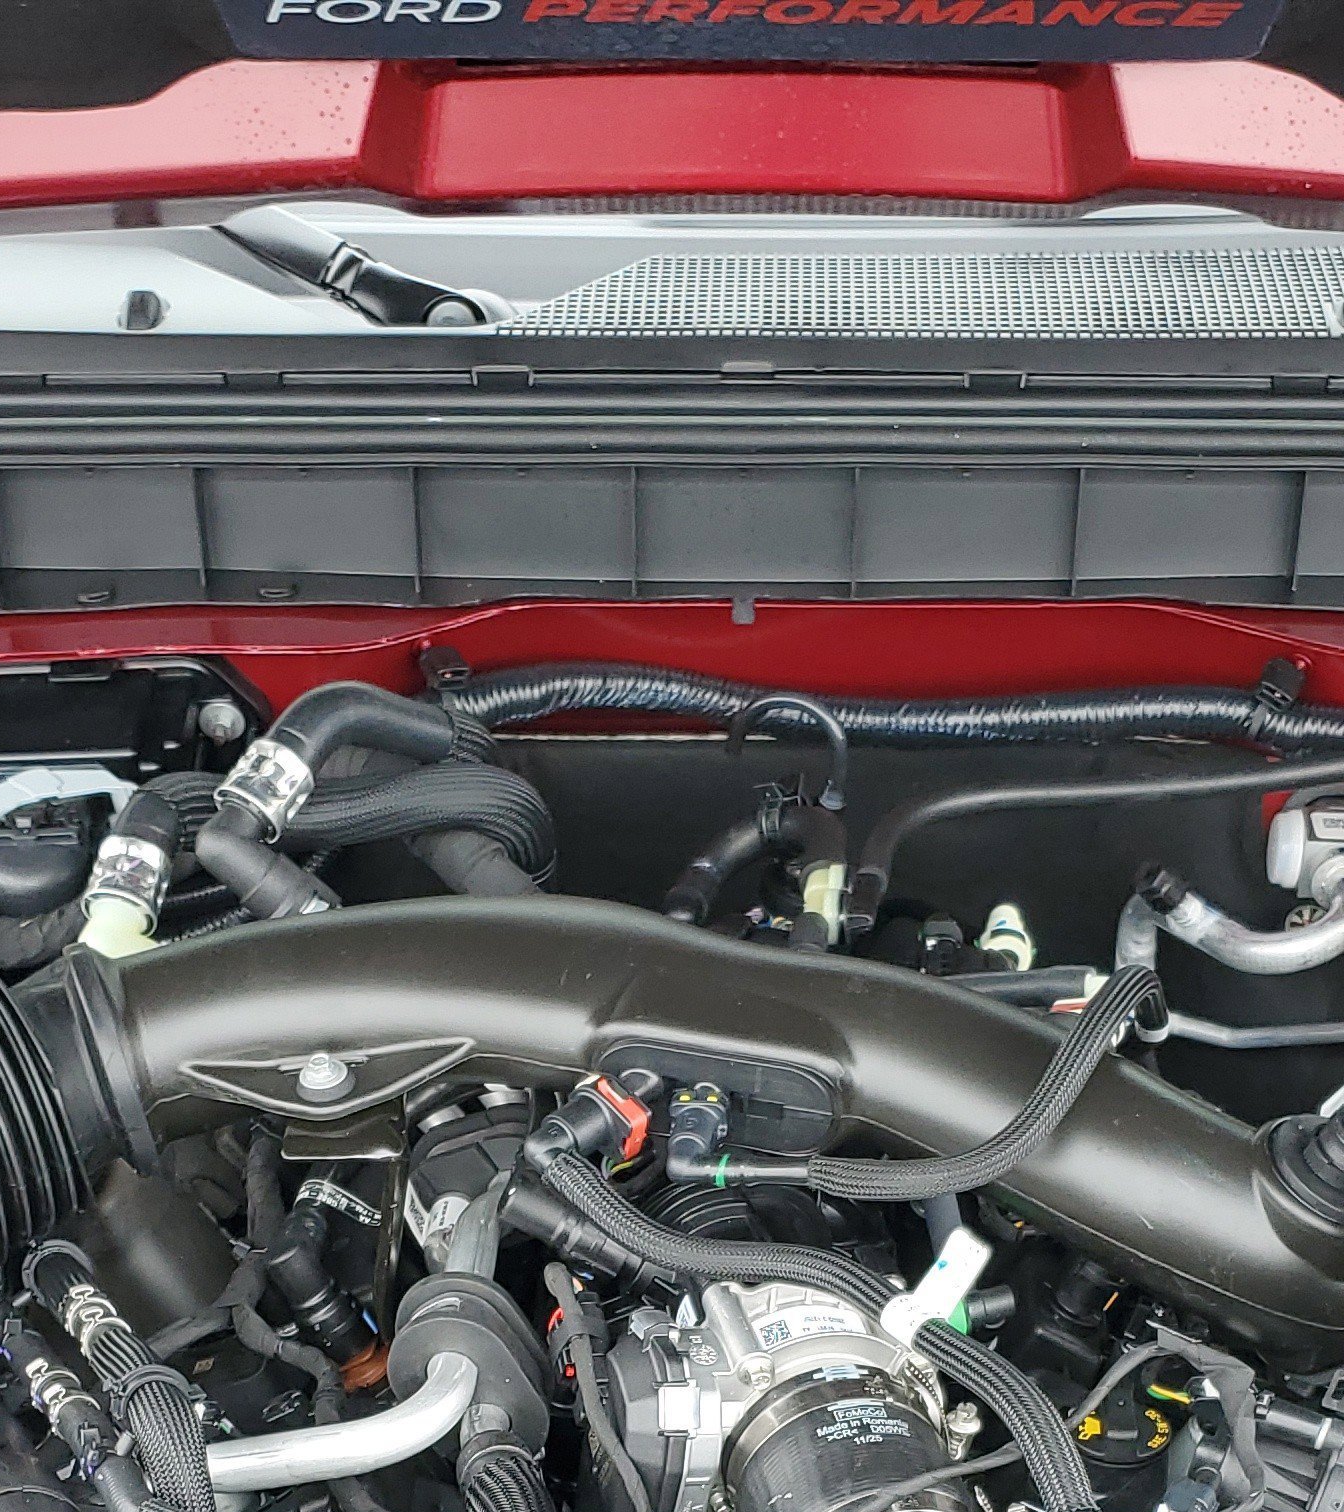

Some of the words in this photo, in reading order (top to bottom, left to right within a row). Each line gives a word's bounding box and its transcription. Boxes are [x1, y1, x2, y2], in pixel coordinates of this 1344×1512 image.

[267, 0, 503, 25] FORD
[524, 0, 1243, 28] PERFORMANCE
[837, 1407, 885, 1419] FoMoCo
[816, 1422, 848, 1437] Made
